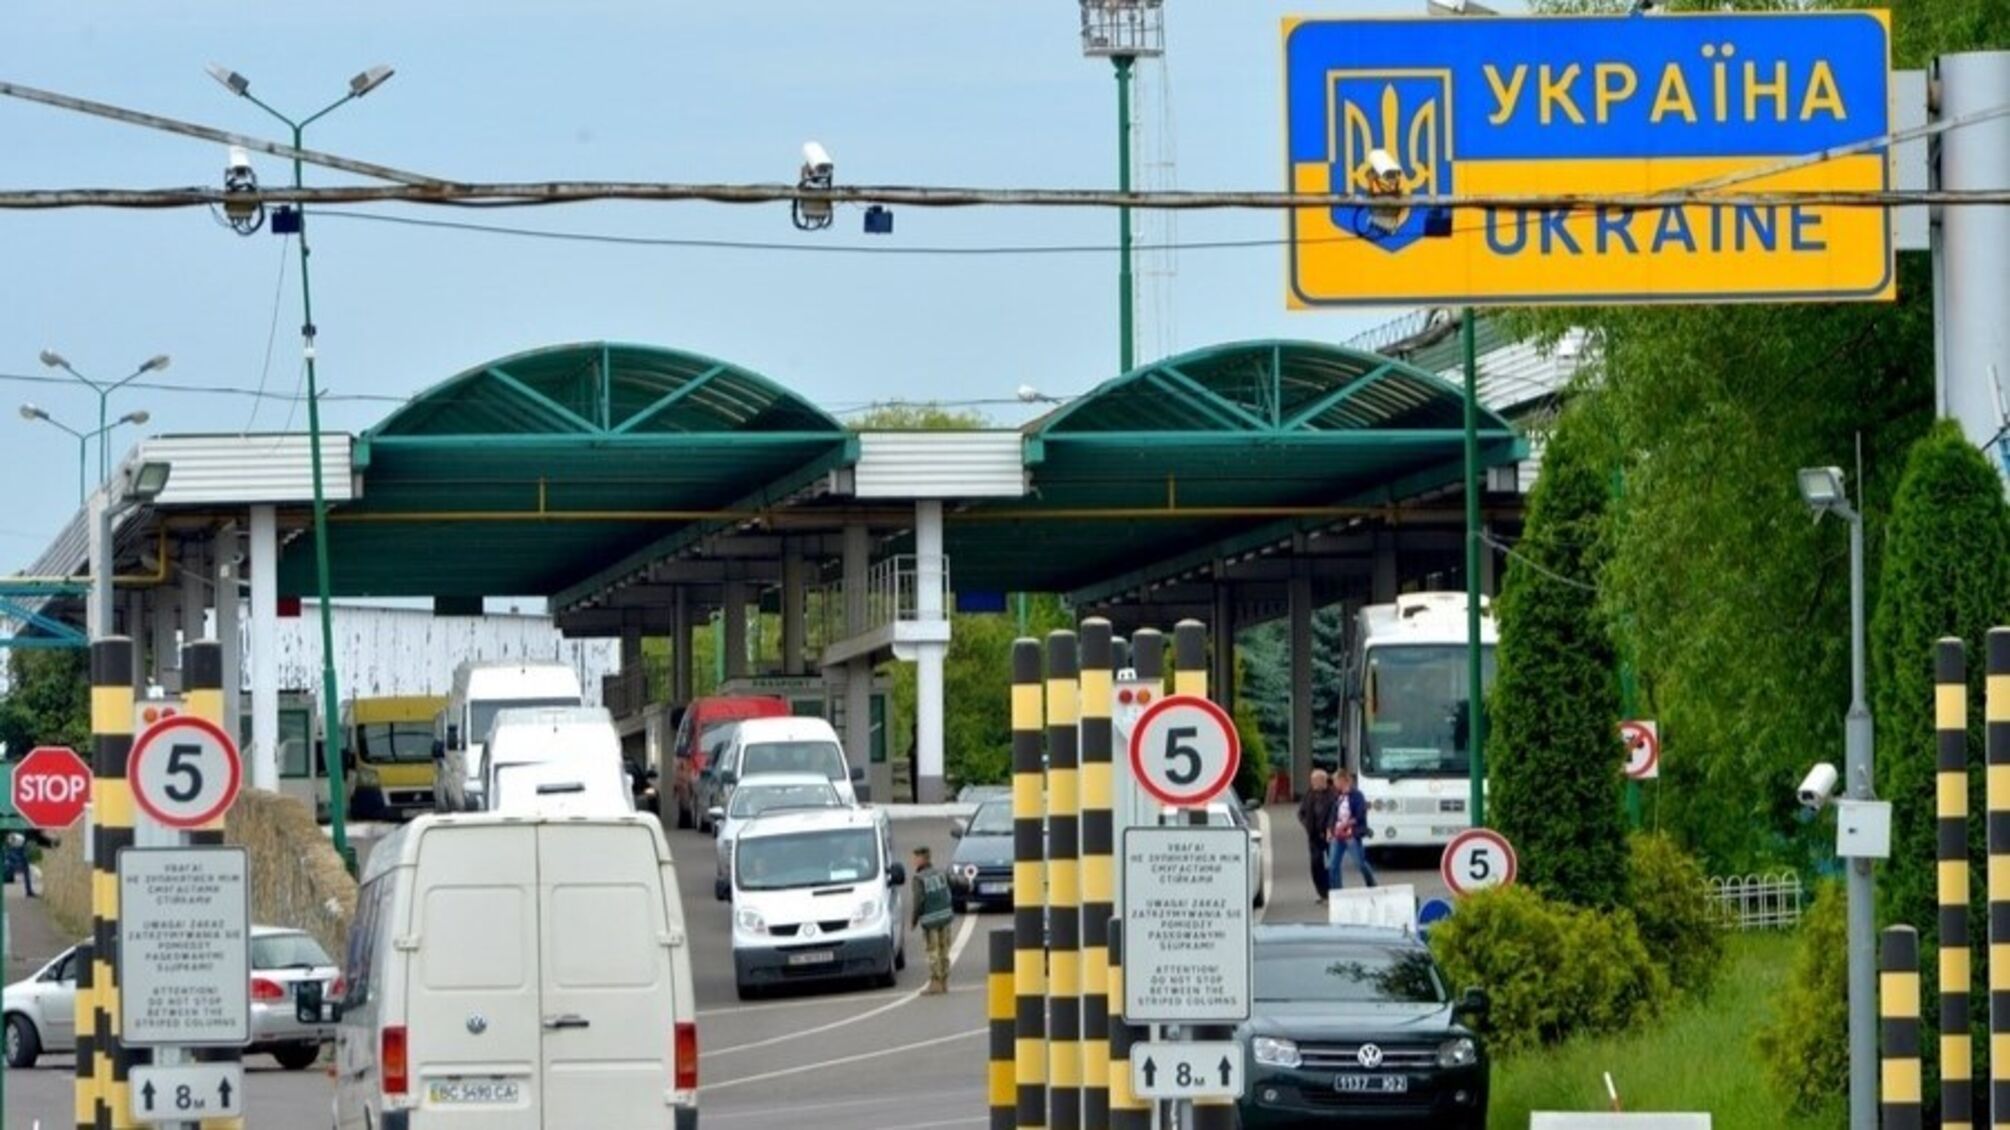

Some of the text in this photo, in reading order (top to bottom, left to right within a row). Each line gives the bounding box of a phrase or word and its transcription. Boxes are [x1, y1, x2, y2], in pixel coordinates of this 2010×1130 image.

[1483, 42, 1848, 125] УКРАЇНА
[1485, 203, 1827, 256] UKRAINE
[1165, 726, 1202, 786] 5
[19, 773, 86, 802] STOP
[164, 744, 203, 802] 5
[1469, 849, 1489, 880] 5
[1191, 898, 1226, 908] ZAKAZ
[1149, 985, 1224, 995] BETWEEN THE
[1150, 975, 1223, 984] DO NOT STOP
[1137, 996, 1237, 1006] STRIPED COLUMNS
